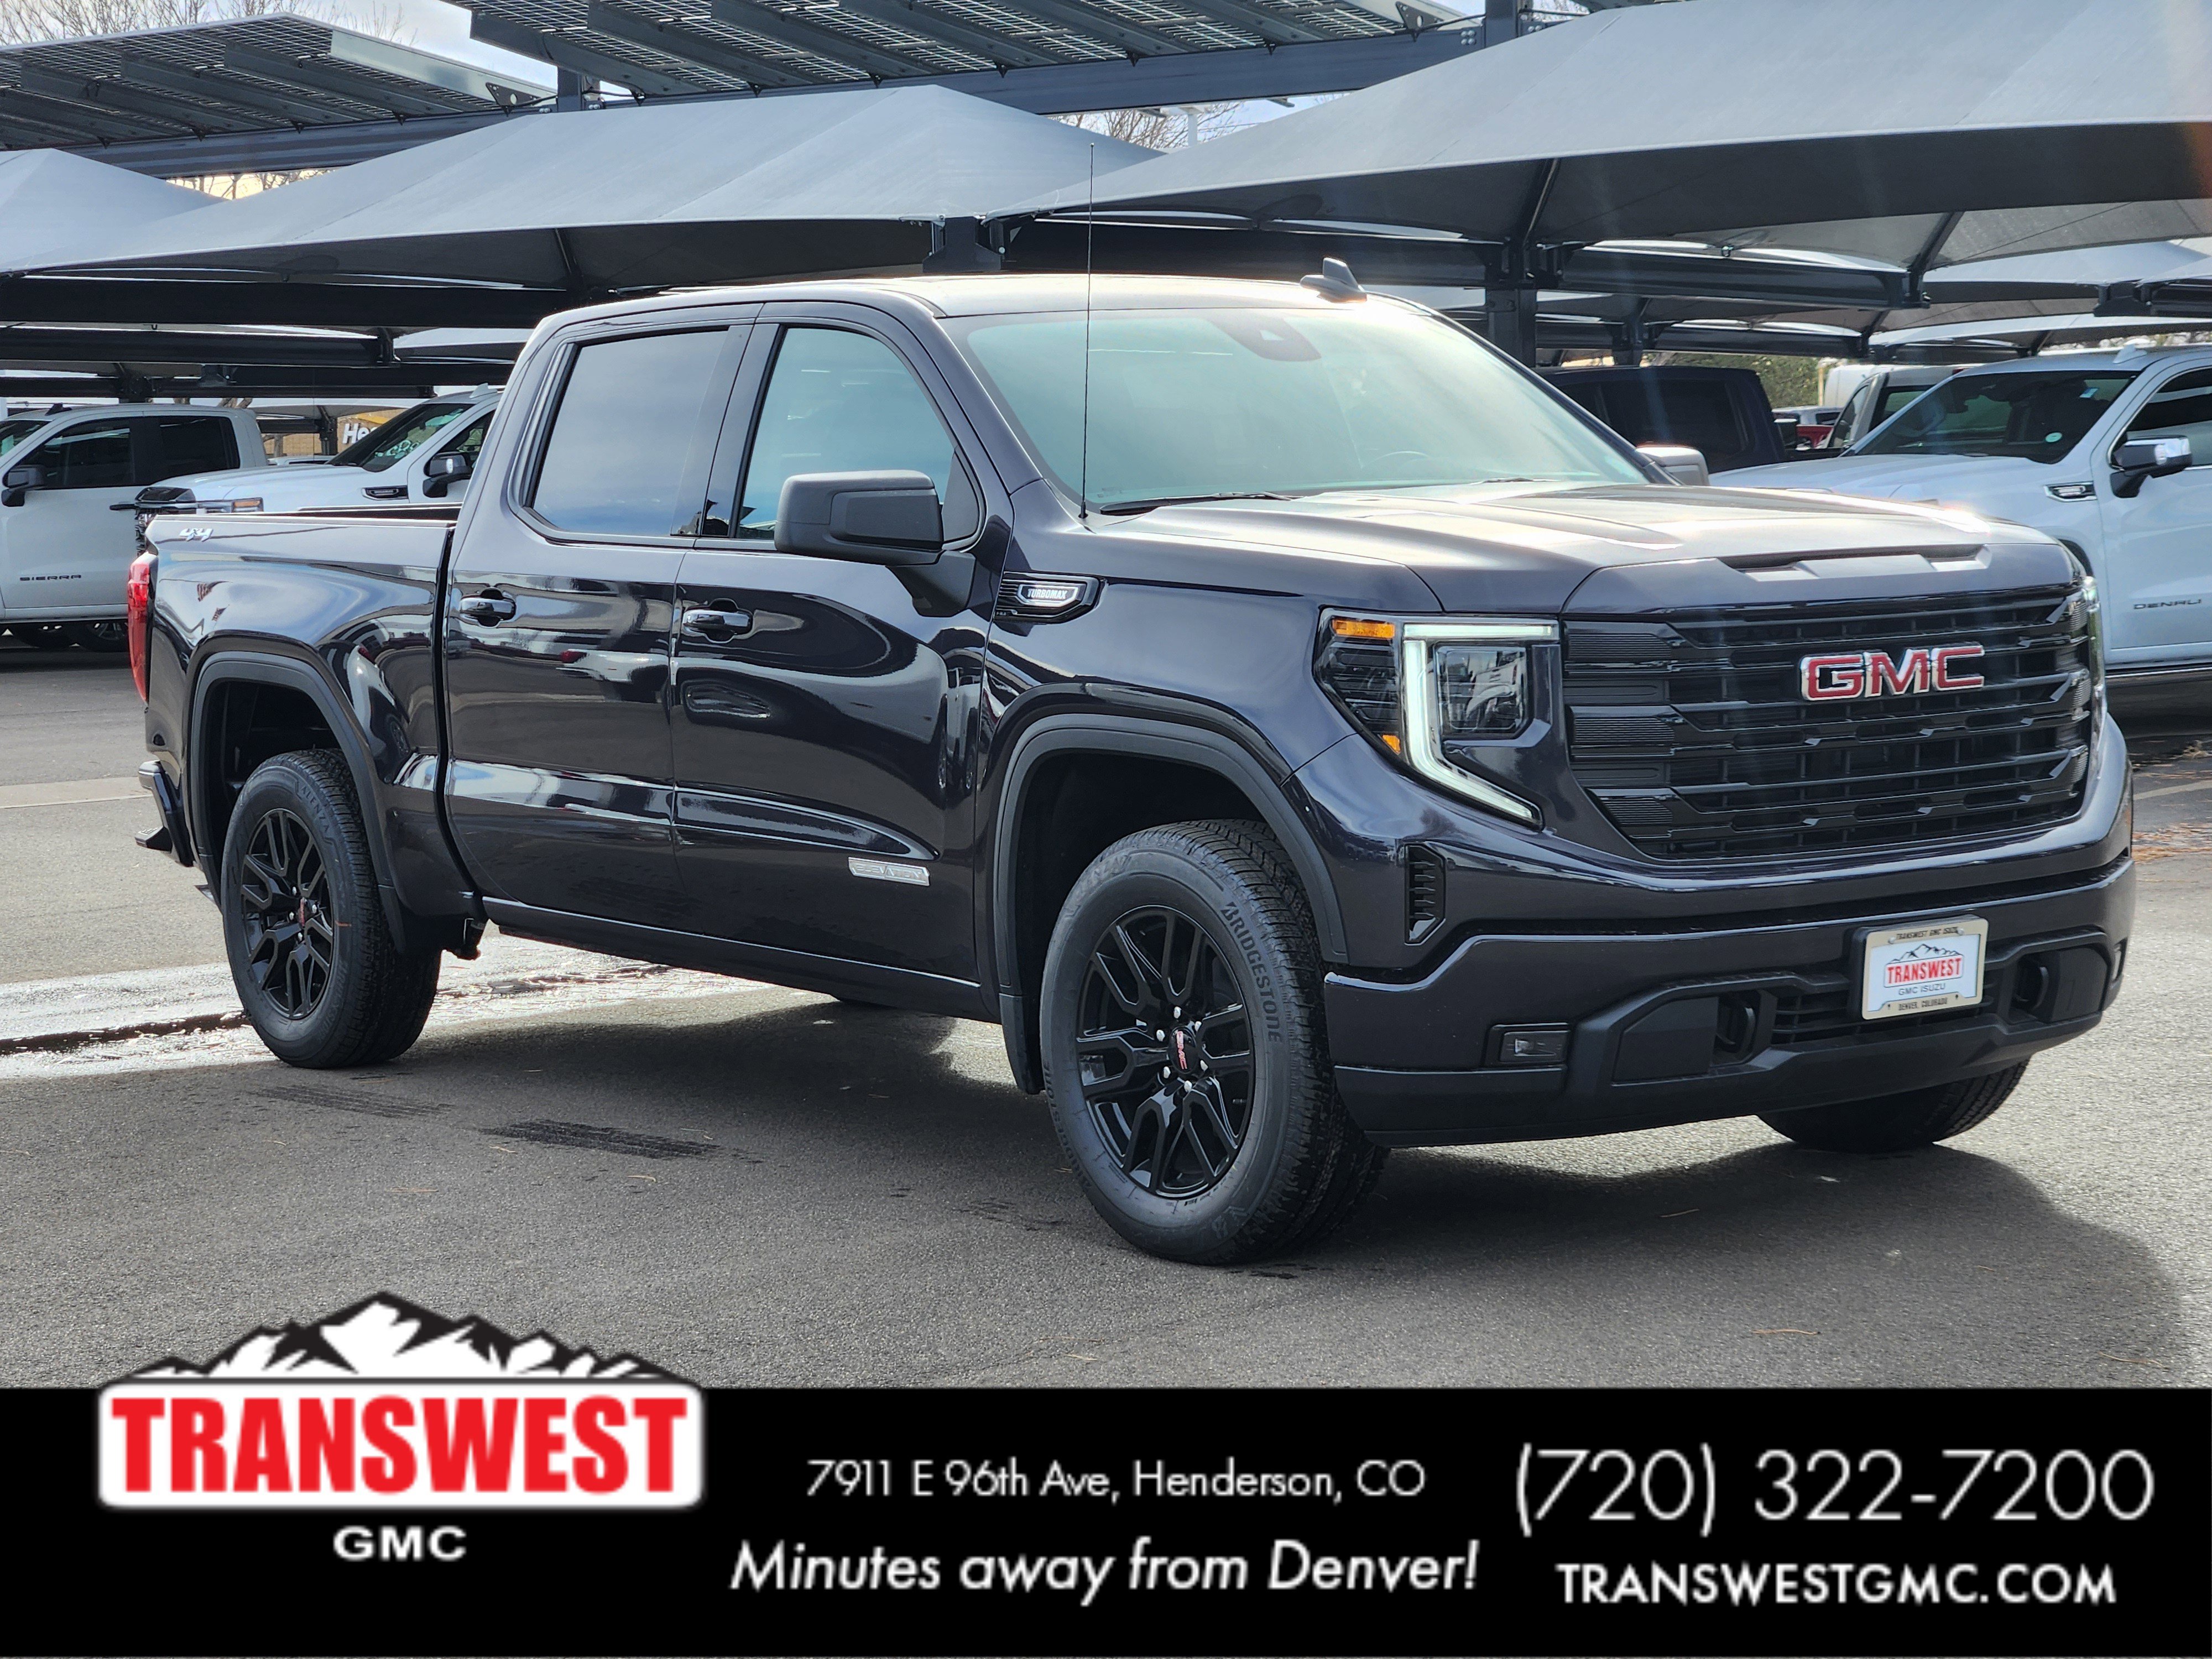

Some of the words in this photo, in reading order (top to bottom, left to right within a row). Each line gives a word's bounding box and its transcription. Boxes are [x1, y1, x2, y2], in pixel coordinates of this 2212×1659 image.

[1027, 588, 1068, 599] TURBOMAX
[2134, 599, 2201, 609] DENALI
[1800, 644, 1985, 701] GMC
[1220, 901, 1283, 1043] BRIDGESTONE
[1887, 958, 1961, 984] TRANSWEST
[1898, 987, 1918, 995] GMC
[1921, 983, 1946, 992] ISUZU
